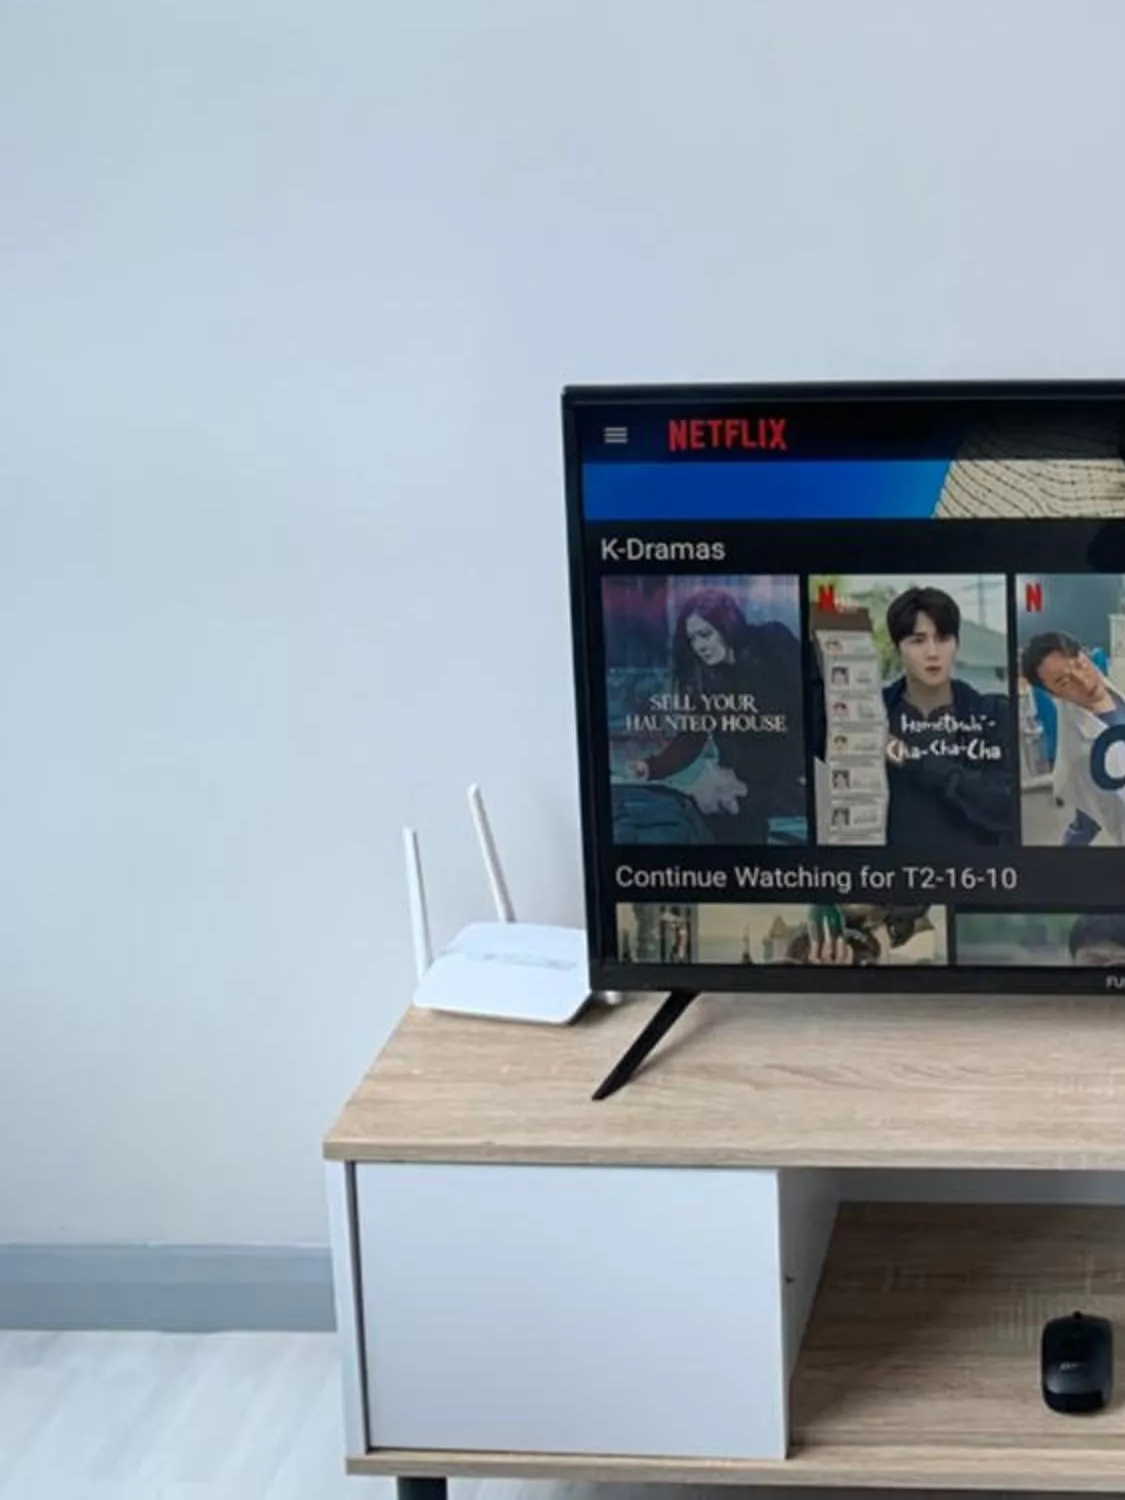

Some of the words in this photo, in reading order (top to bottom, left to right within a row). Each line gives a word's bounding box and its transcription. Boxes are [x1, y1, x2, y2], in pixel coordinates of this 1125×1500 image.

[668, 418, 788, 452] NETFLIX
[600, 537, 726, 562] K-Dramas
[650, 693, 696, 712] SELL
[701, 693, 759, 713] YOUR
[625, 714, 717, 732] HAUNTED
[721, 713, 788, 733] HOUSE
[615, 865, 727, 889] Continue
[734, 866, 851, 893] Watching
[860, 865, 895, 889] for
[902, 867, 1017, 890] T2-16-10
